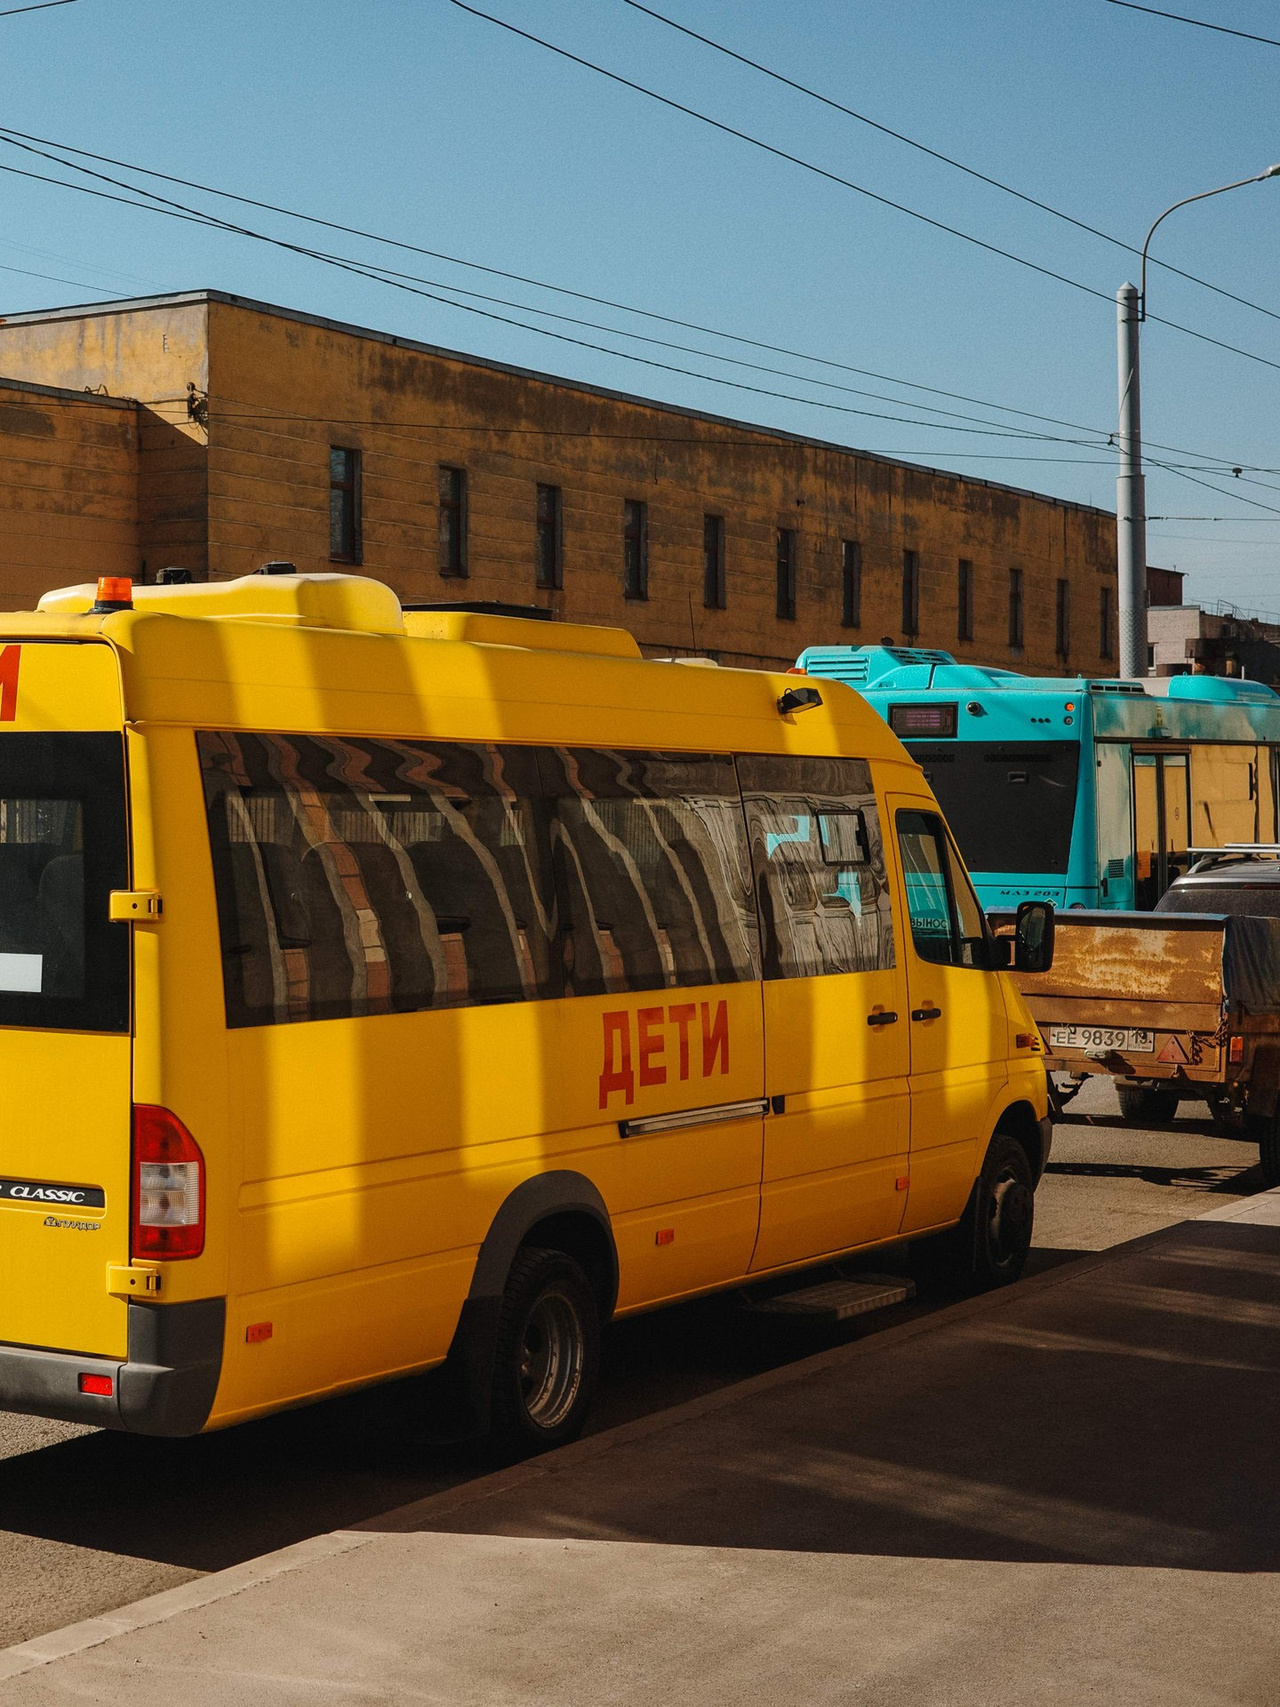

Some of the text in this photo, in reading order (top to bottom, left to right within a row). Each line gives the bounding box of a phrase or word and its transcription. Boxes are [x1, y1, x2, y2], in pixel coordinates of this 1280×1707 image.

[1081, 1029, 1125, 1048] 9839
[598, 999, 730, 1110] ДЕТИ
[9, 1185, 86, 1204] CLASSIC
